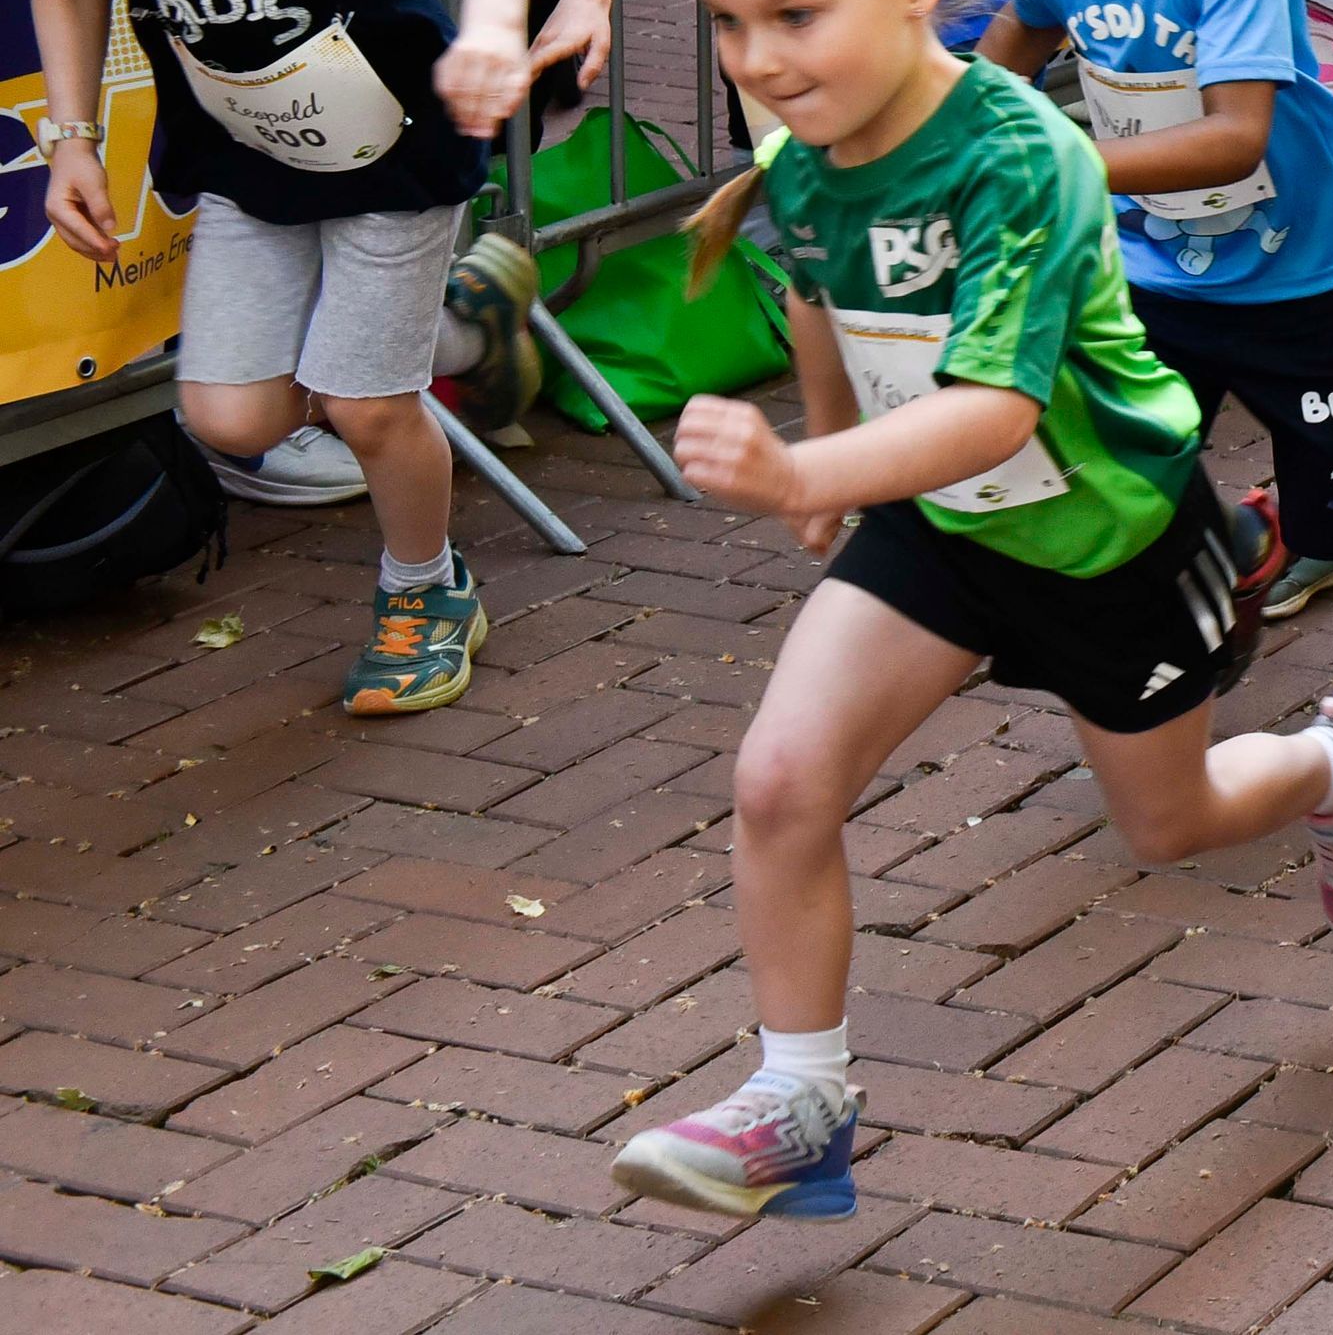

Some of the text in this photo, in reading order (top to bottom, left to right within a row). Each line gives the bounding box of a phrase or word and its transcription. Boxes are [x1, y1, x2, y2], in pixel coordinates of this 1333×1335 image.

[224, 85, 324, 126] Leopold
[95, 232, 196, 293] Meine Ene
[387, 597, 425, 611] FILA
